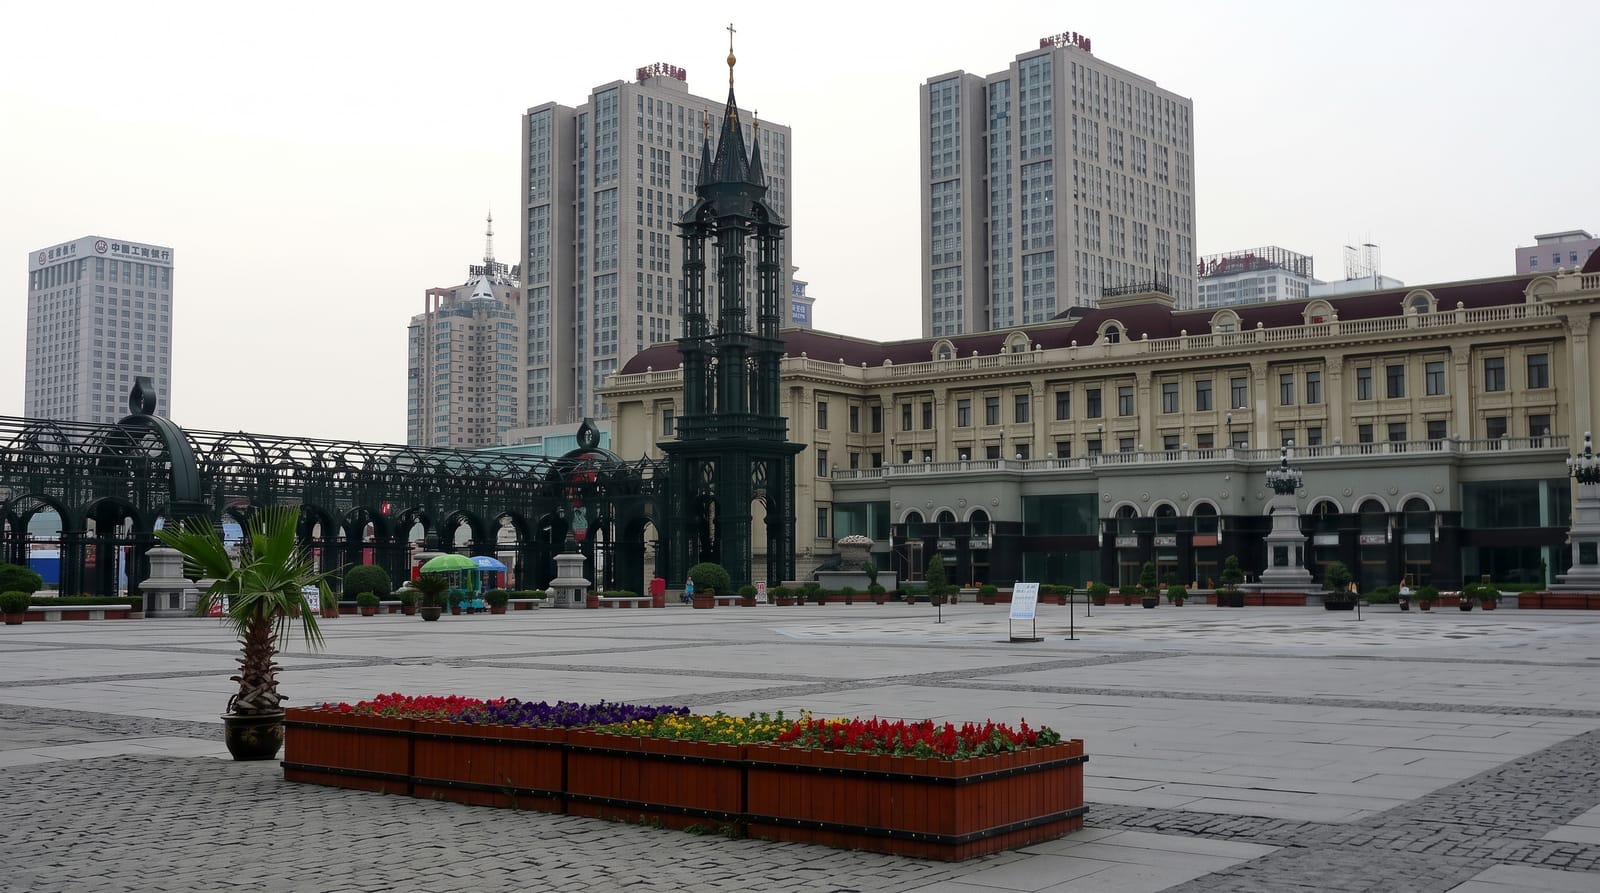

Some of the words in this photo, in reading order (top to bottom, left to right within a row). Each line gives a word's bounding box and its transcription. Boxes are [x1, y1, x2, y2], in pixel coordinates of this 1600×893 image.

[112, 243, 169, 260] 中国工商银行
